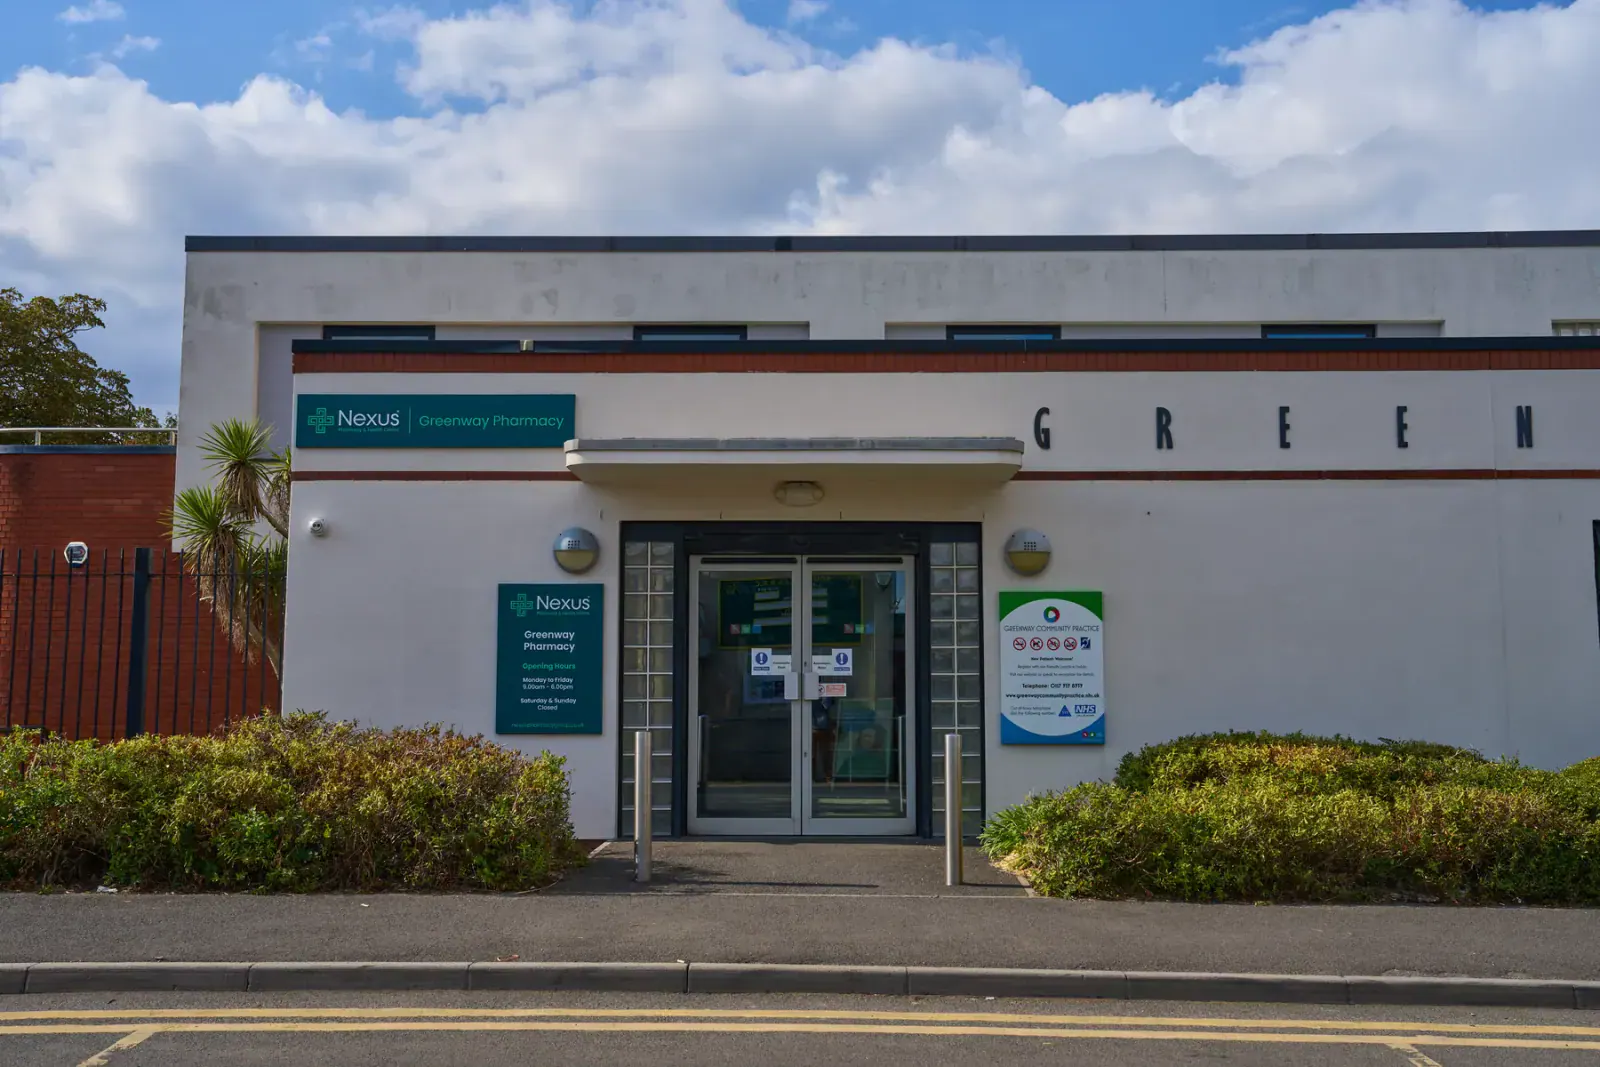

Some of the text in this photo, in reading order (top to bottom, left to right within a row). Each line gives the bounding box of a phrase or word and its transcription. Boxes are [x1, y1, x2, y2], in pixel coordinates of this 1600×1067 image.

[338, 409, 400, 427] Nexus
[419, 415, 565, 430] Greenway Pharmacy
[536, 595, 591, 610] Nexus
[524, 630, 575, 641] Greenway
[523, 642, 575, 653] Pharmacy
[522, 662, 576, 671] Opening Hours
[1076, 705, 1095, 713] NHS
